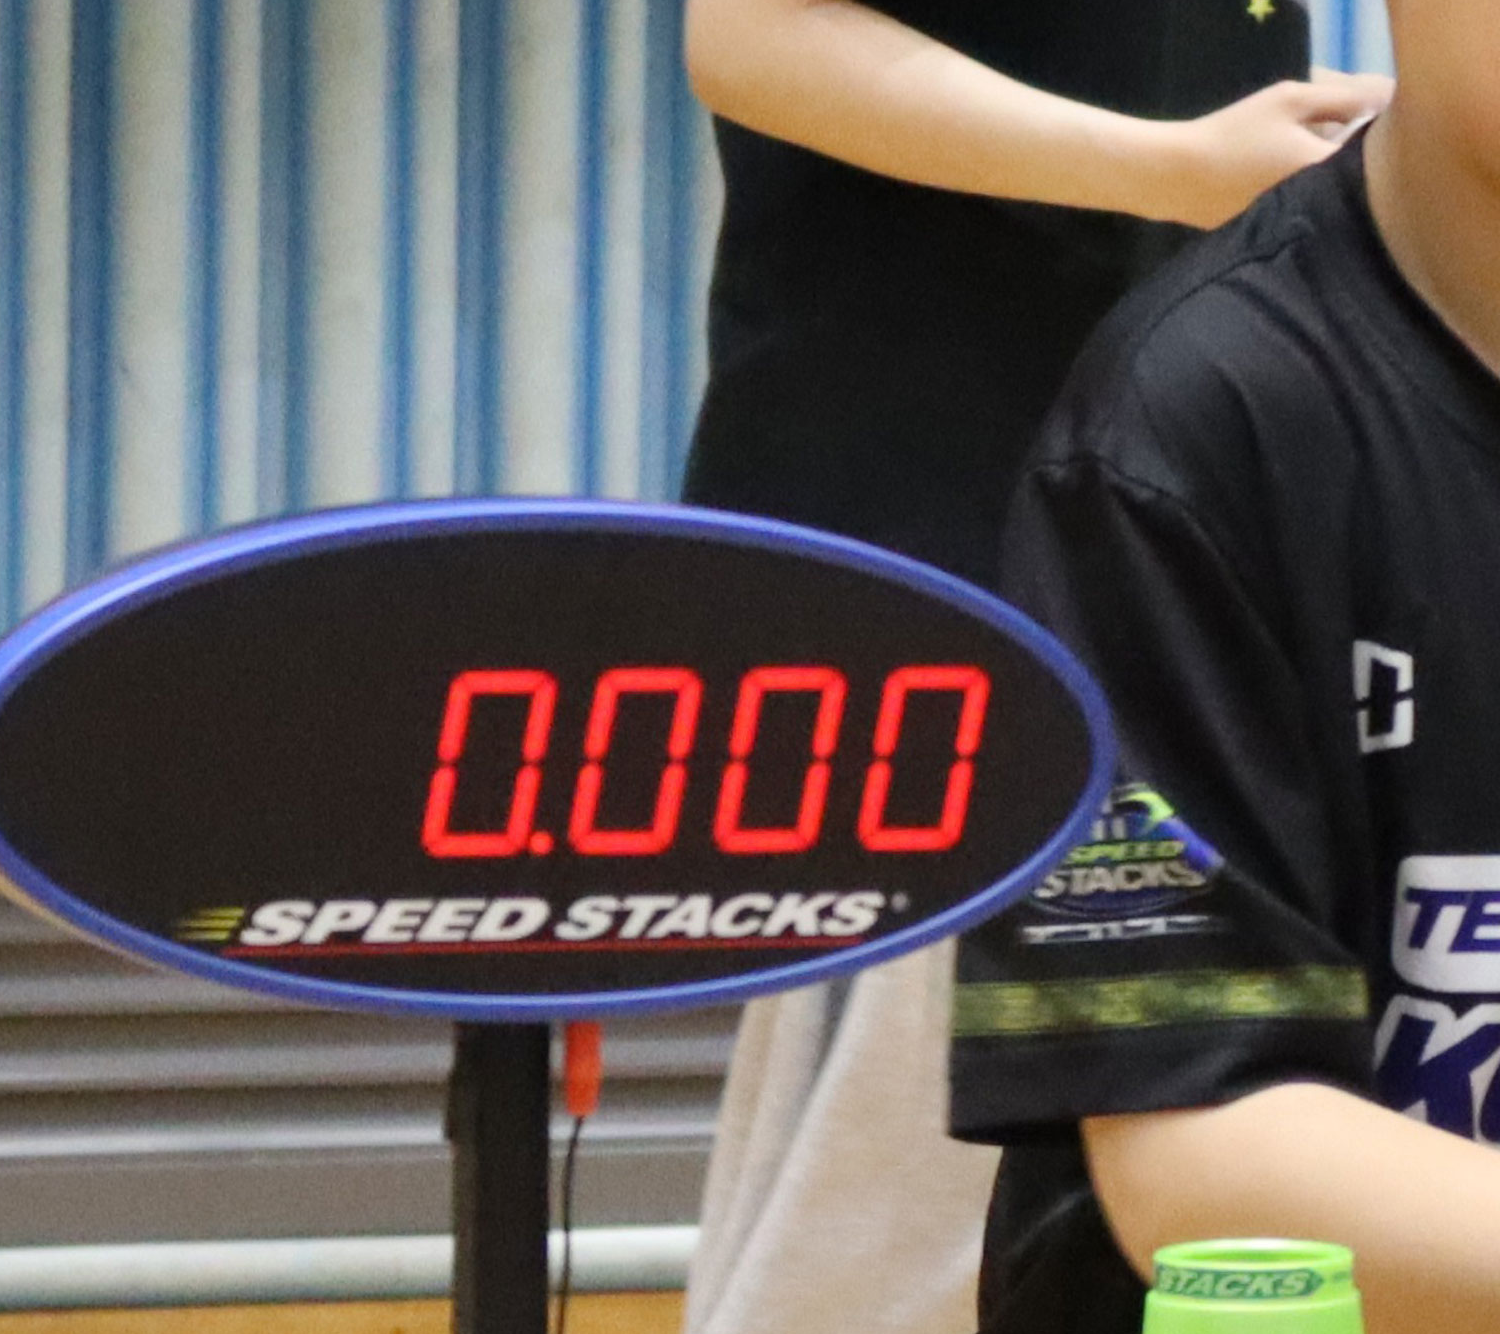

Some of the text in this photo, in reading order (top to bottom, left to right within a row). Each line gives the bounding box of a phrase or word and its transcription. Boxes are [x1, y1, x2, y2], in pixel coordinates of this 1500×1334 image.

[421, 668, 990, 857] 0.000
[1032, 860, 1207, 898] STACKS
[238, 891, 887, 946] SPEED STACKS
[1157, 1267, 1310, 1298] STACKS
